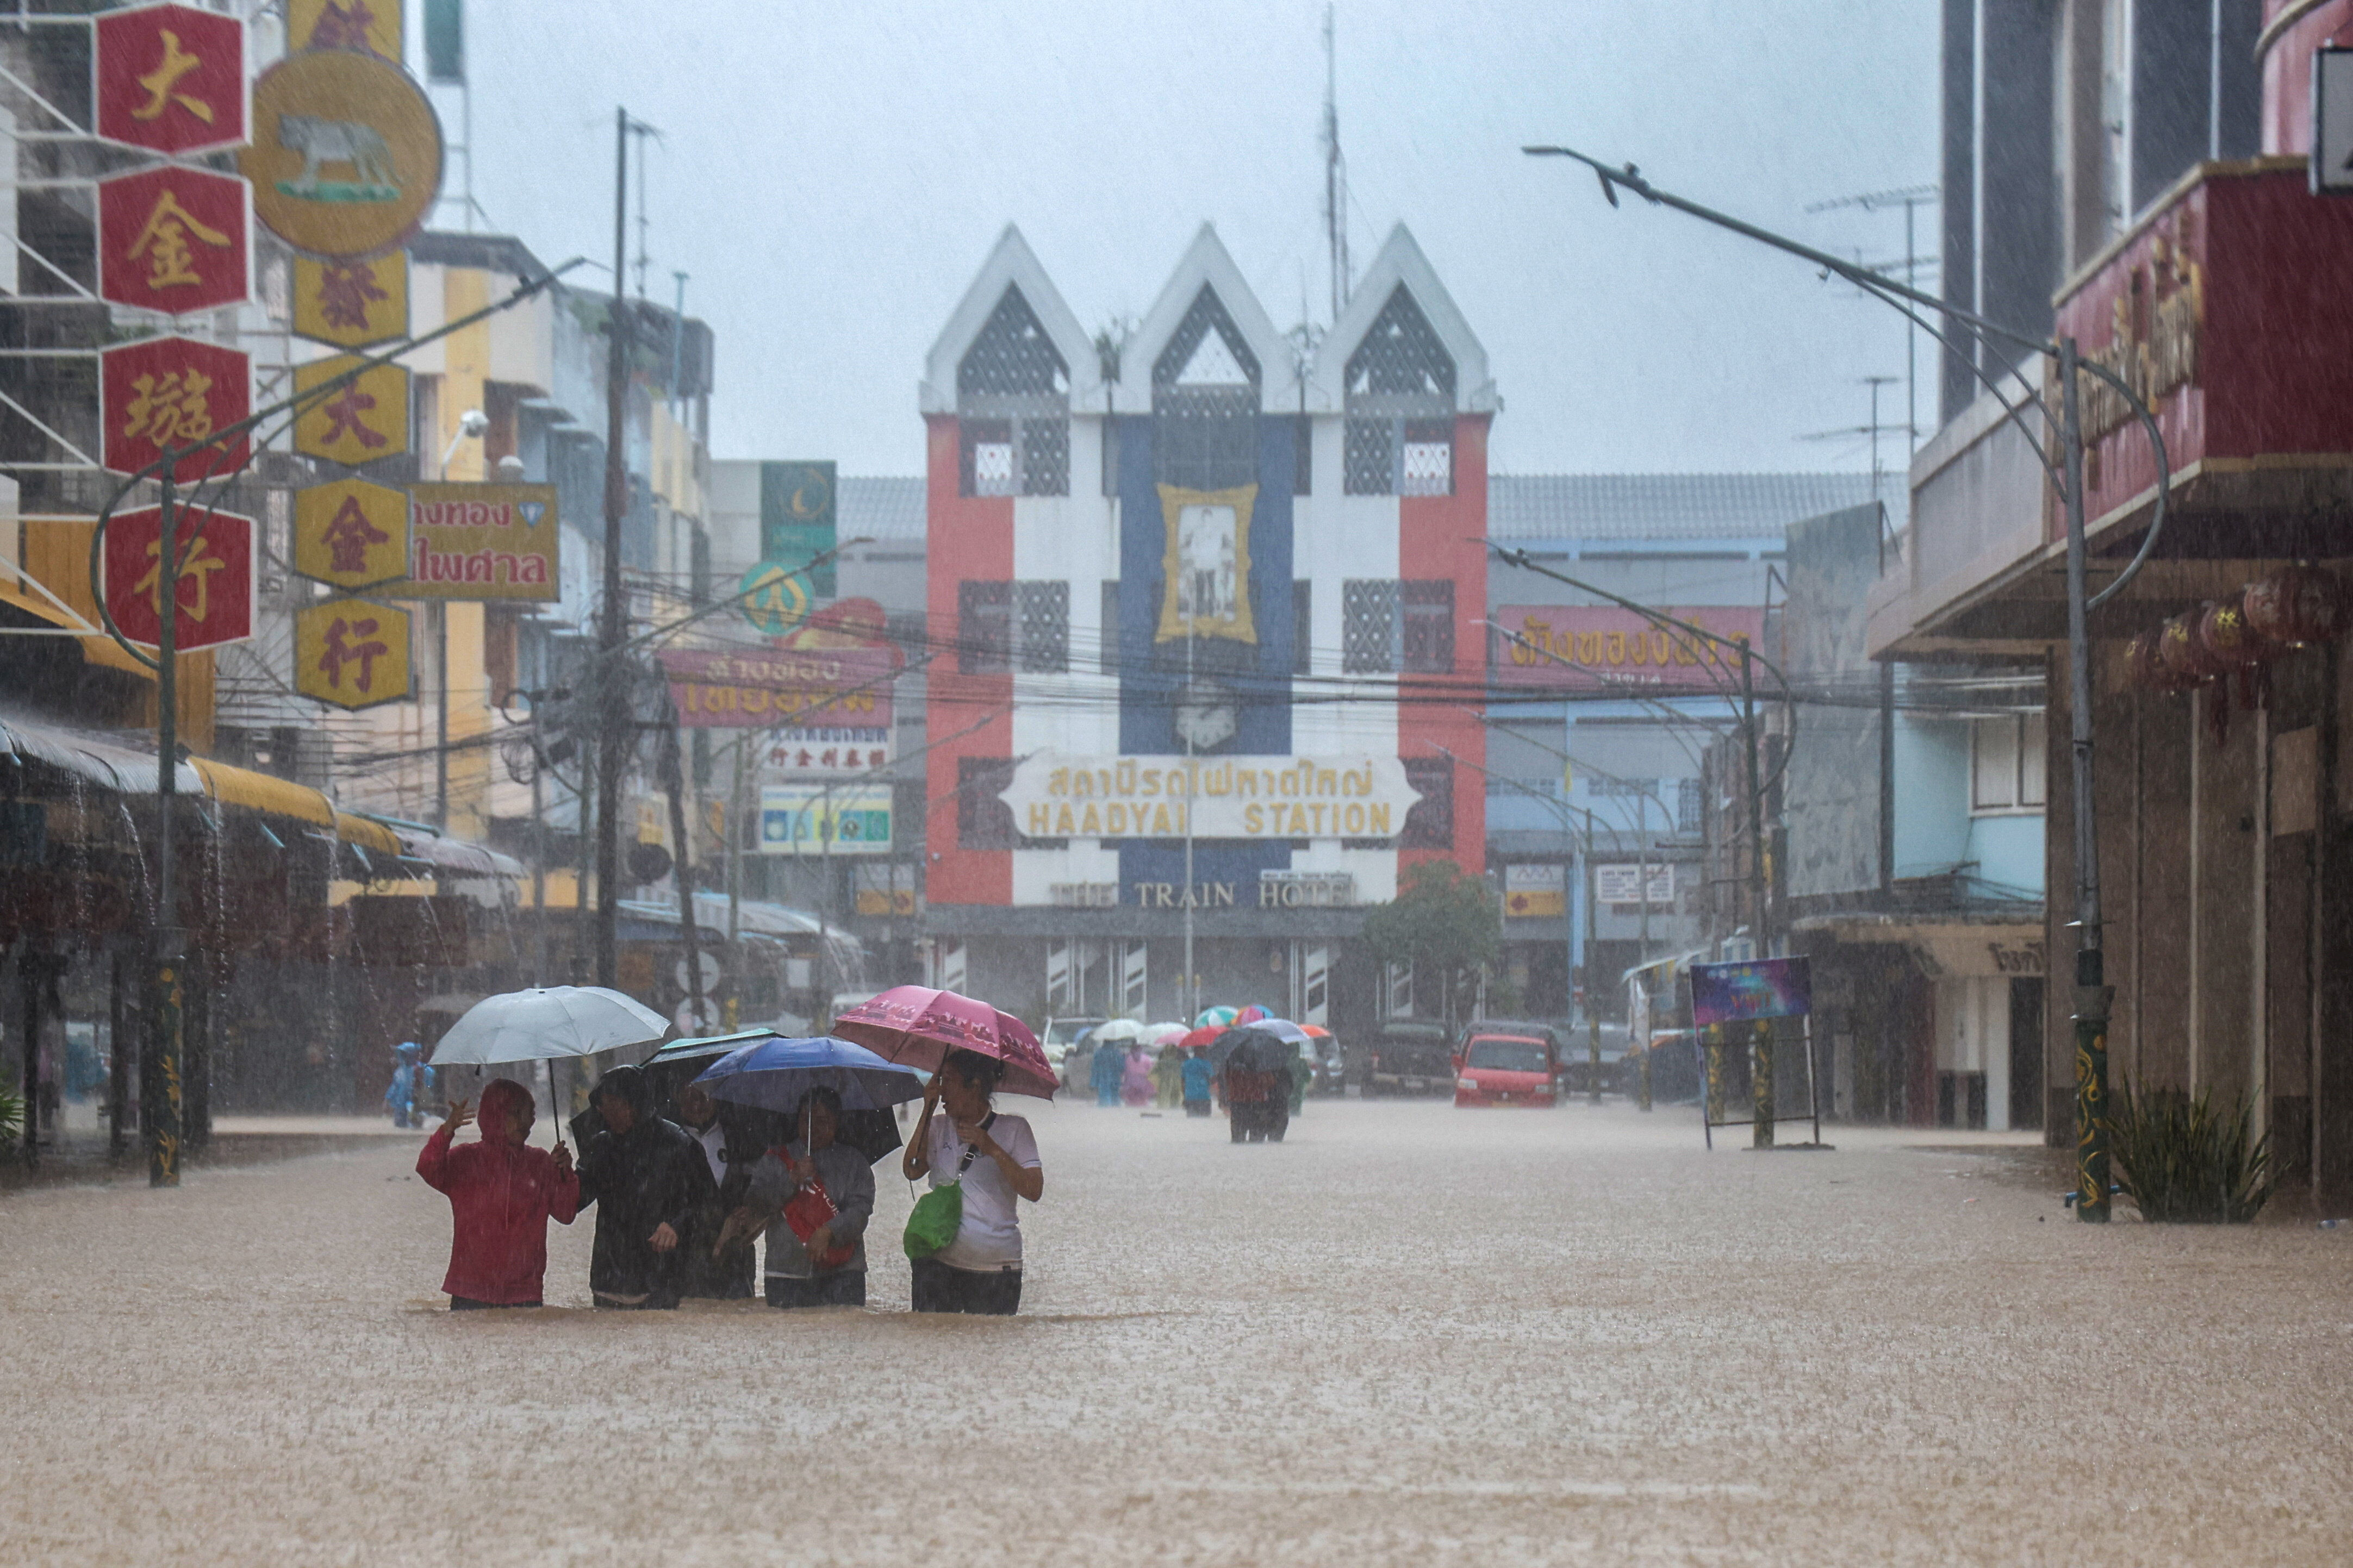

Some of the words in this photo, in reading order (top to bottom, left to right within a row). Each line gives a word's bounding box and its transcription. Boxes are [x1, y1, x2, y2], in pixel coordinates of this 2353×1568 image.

[412, 536, 547, 583] ไพศาล
[1048, 758, 1374, 797] สถานีรถไฟหาดใหญ่
[1028, 802, 1186, 835] HAADYAI
[1244, 802, 1390, 834] STATION
[1052, 882, 1117, 907] THE
[1134, 881, 1237, 908] TRAIN
[1258, 880, 1357, 909] HOTEL
